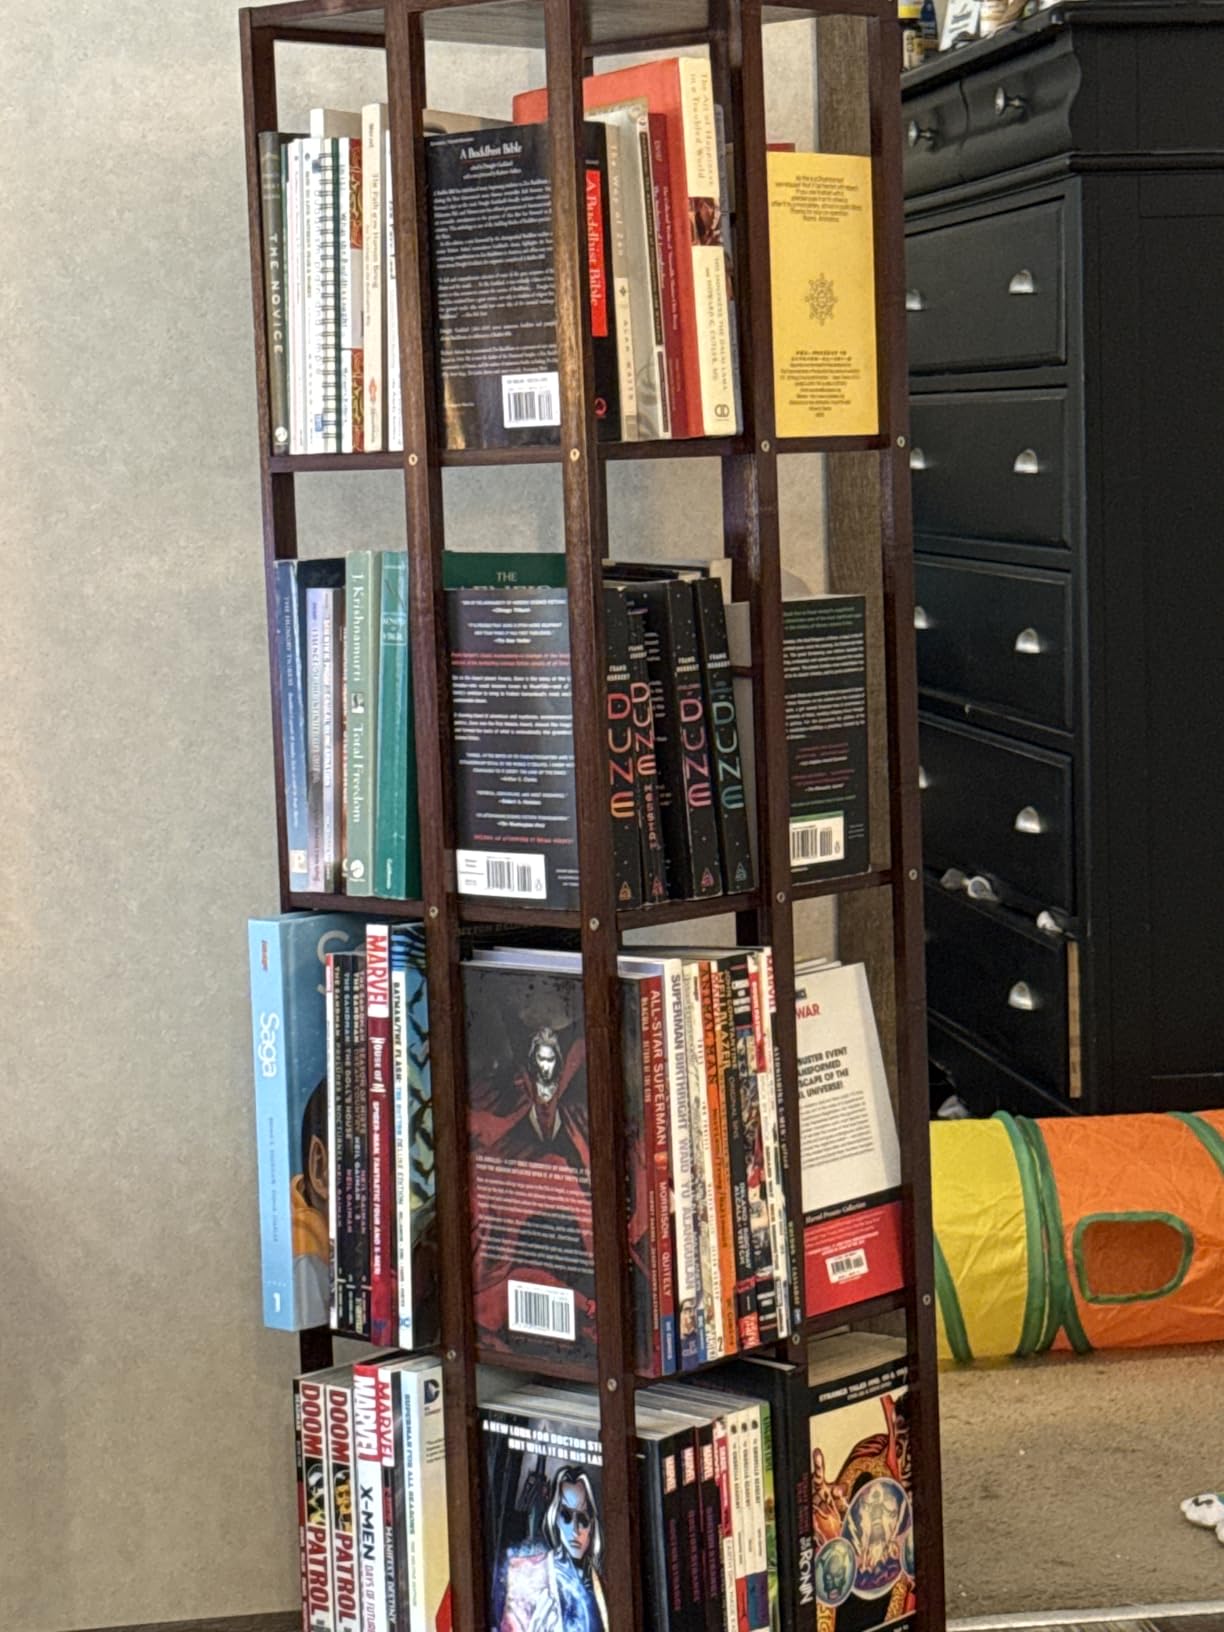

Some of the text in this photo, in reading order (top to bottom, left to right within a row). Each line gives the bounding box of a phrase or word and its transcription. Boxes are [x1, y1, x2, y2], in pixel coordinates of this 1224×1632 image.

[701, 73, 709, 91] The
[693, 97, 702, 143] Troubled
[705, 114, 711, 125] of
[697, 147, 707, 179] World
[705, 130, 714, 185] Happiness
[587, 180, 602, 307] A Buddhist Bible
[269, 232, 284, 353] THE NOVICE
[496, 571, 518, 582] THE
[352, 586, 365, 682] Krishnamurti
[607, 693, 635, 818] DUNE
[630, 682, 657, 776] DUNE
[680, 699, 712, 807] DUNE
[712, 701, 745, 810] DUNE
[353, 723, 365, 823] Total Freedom
[366, 936, 388, 1006] MARVEL
[393, 982, 401, 1046] BATMAN/THE
[671, 975, 685, 1050] SUPERMAN
[796, 1003, 820, 1019] WAR
[258, 1012, 280, 1077] Saga
[369, 1037, 387, 1094] HOUSE OF M
[650, 990, 667, 1146] ALL-STAR SUPERMAN
[774, 1046, 784, 1105] ASTONISHING
[824, 1068, 849, 1081] OF THE
[825, 1046, 848, 1059] EVENT
[360, 1089, 366, 1101] OF
[675, 1052, 687, 1129] BIRTHRIGHT
[806, 1081, 844, 1098] UNIVERSE!
[679, 1137, 690, 1173] WAID
[373, 1157, 382, 1275] FANTASTIC FOUR AND X-MEN
[681, 1183, 691, 1199] YU
[739, 1181, 747, 1220] DELANO
[659, 1181, 671, 1297] MORRISON QUITELY
[734, 1185, 746, 1265] ALCALA VEITCH
[272, 1292, 281, 1313] 1
[355, 1376, 378, 1461] MARVEL
[377, 1382, 392, 1459] MARVEL
[405, 1393, 413, 1448] SUPERMAN
[483, 1420, 586, 1449] A NEW LOOK FOR DOCTOR
[508, 1438, 586, 1463] BUT WILL IT BE HIS
[301, 1383, 330, 1616] DOOM PATROL
[329, 1389, 357, 1623] DOOM PATROL
[361, 1485, 376, 1600] X-MEN DAYS OF
[798, 1548, 814, 1606] RONIN
